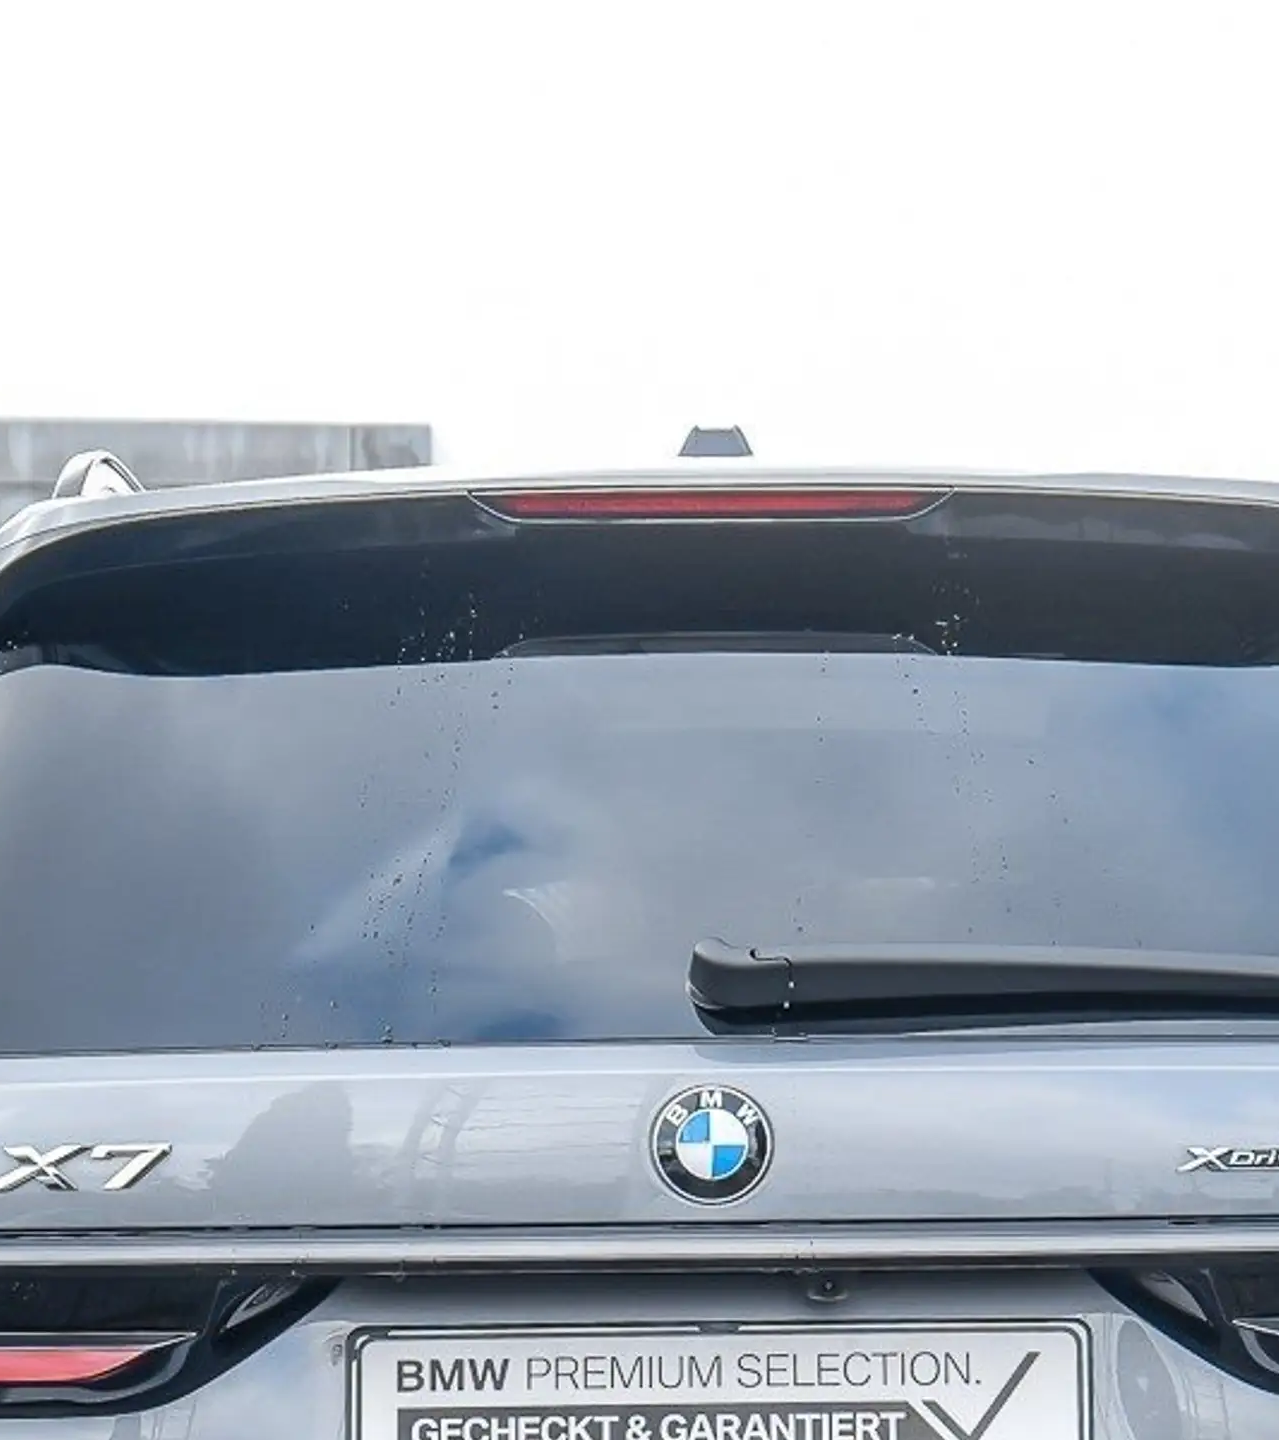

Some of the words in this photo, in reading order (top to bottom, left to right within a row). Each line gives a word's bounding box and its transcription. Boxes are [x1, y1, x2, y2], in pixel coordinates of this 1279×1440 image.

[665, 1091, 760, 1127] BMW
[396, 1358, 510, 1393] BMW
[526, 1354, 722, 1391] PREMIUM
[737, 1350, 981, 1389] SELECTION.
